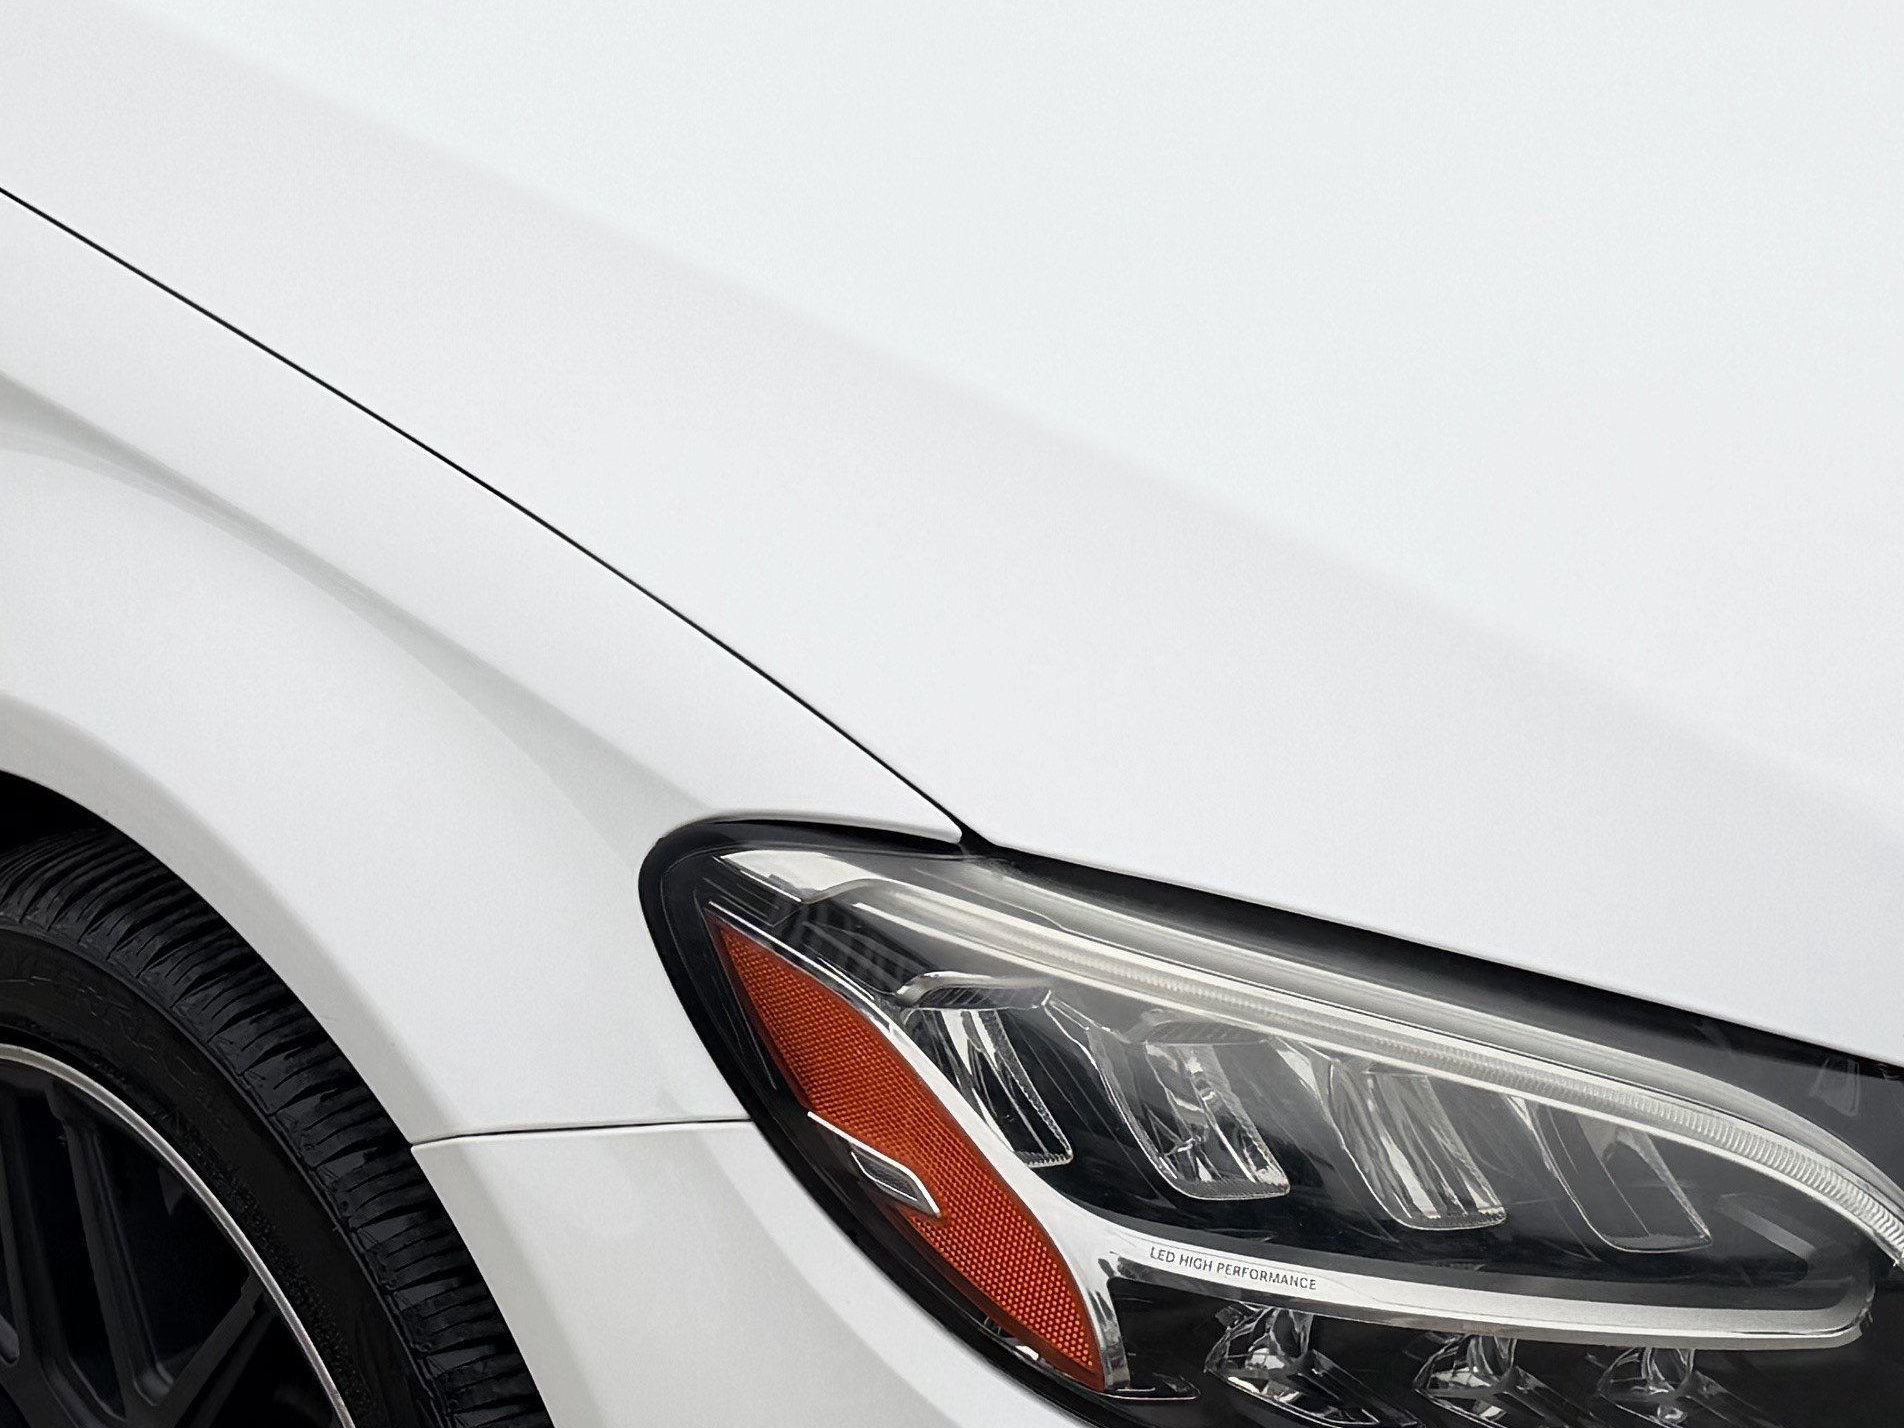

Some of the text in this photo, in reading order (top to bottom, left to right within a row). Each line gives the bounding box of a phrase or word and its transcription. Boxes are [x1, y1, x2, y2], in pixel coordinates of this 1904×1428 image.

[1149, 1246, 1317, 1291] LED HIGH PERFORMANCE
